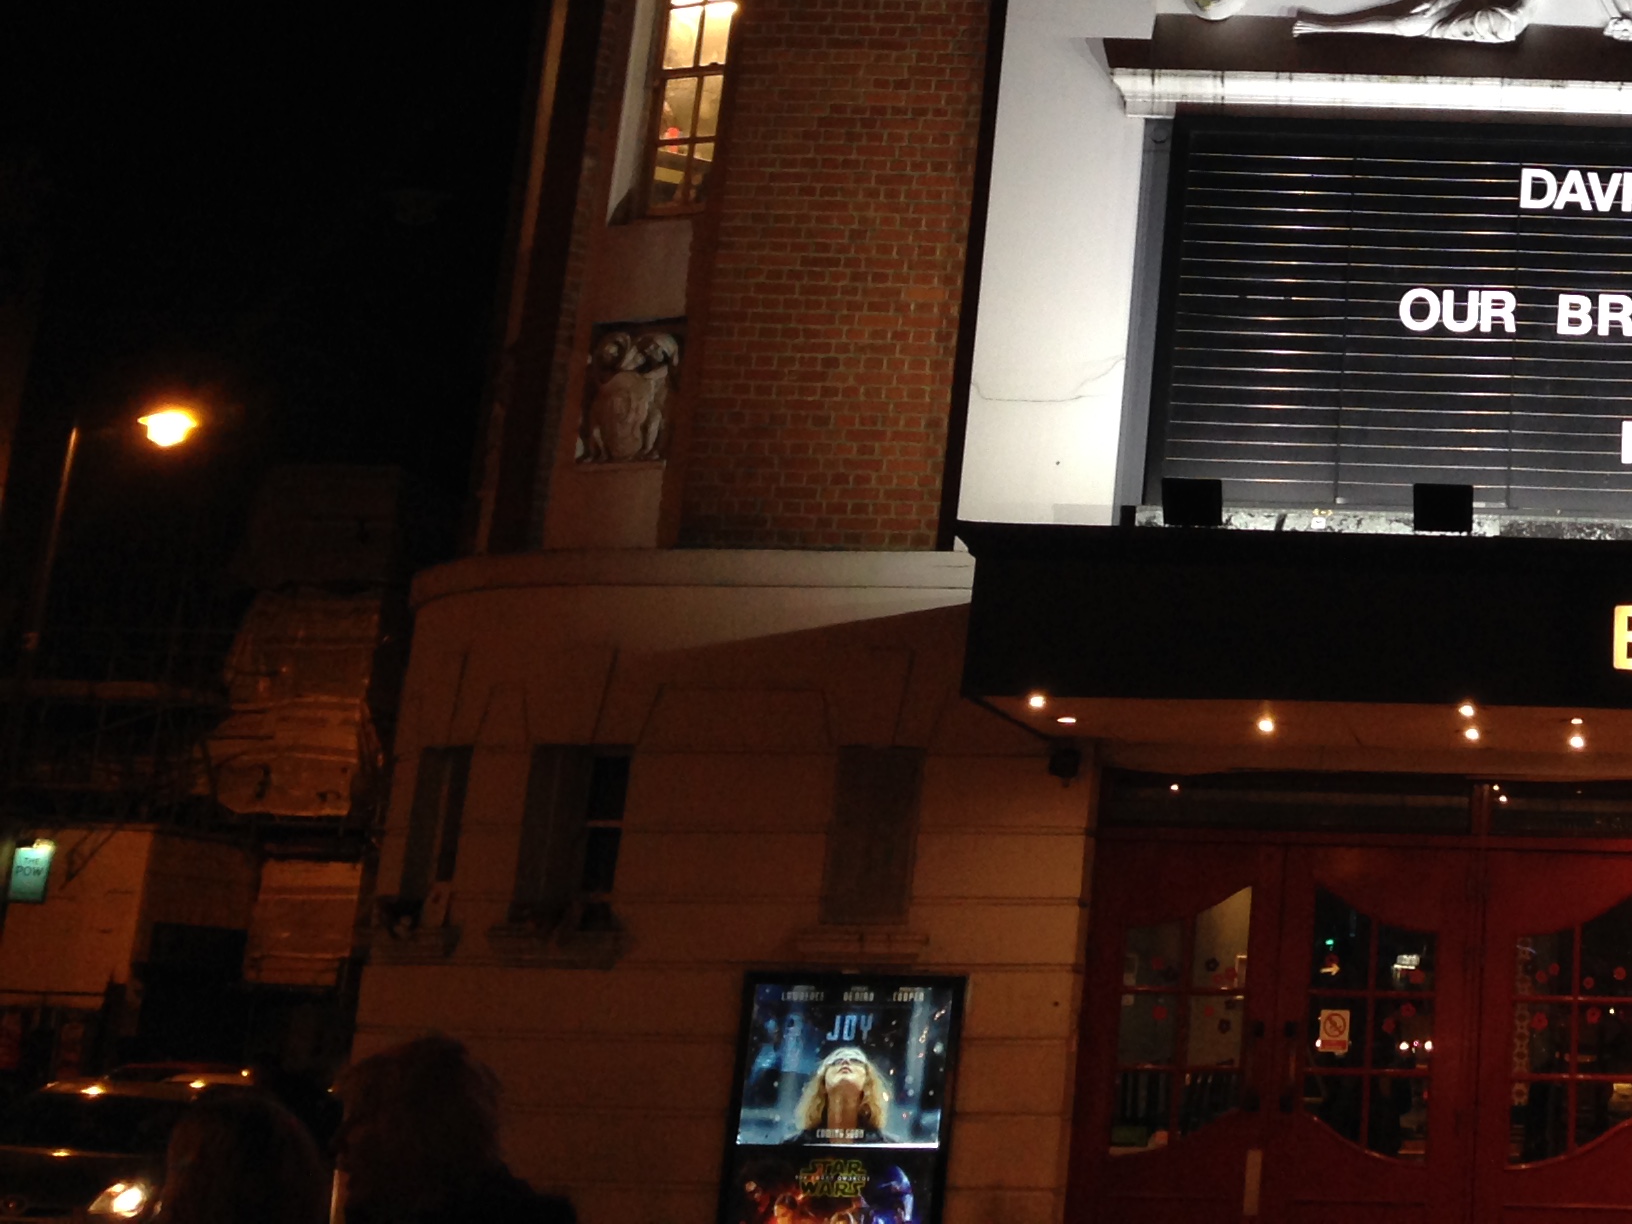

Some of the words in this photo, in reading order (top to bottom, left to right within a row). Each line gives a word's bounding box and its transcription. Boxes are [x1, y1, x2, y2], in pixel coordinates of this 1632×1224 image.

[1399, 288, 1518, 334] OUR
[826, 1014, 874, 1044] JOY
[800, 1159, 868, 1176] STAR
[799, 1179, 865, 1198] WARS
